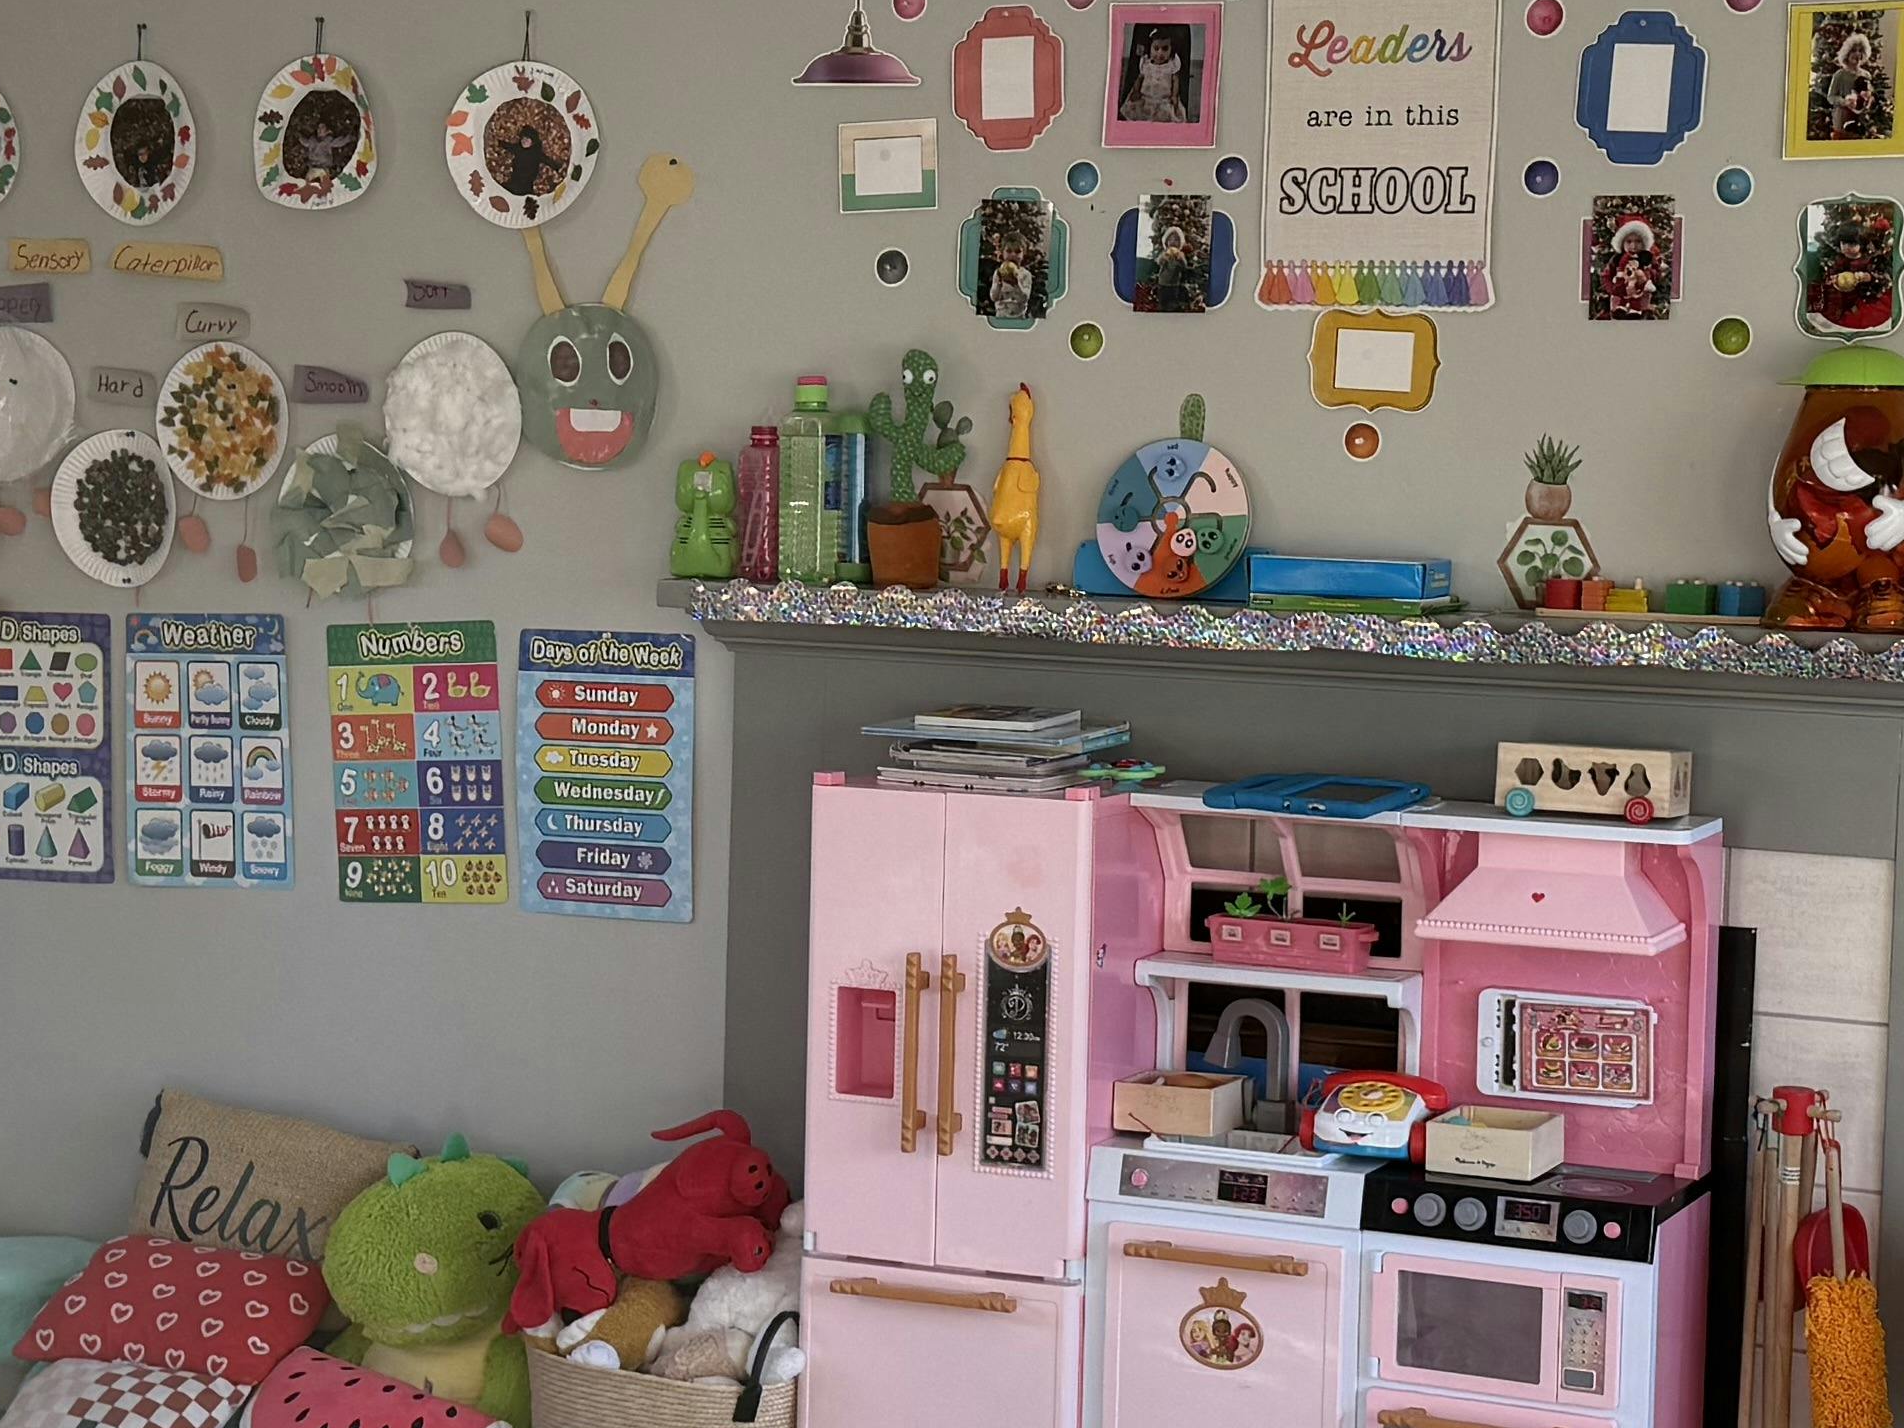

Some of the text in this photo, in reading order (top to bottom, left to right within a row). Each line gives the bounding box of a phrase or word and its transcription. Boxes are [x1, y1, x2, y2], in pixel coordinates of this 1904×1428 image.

[1288, 20, 1472, 78] Leaders
[1307, 104, 1459, 127] are in this
[1279, 166, 1476, 214] SCHOOL
[15, 243, 218, 273] Sensory Caterpillar
[184, 308, 238, 334] Curvy
[98, 373, 144, 399] Hard
[21, 623, 79, 644] Shapes
[162, 621, 254, 649] Weather
[359, 632, 463, 657] Numbers
[533, 638, 682, 668] Days of the Week
[336, 673, 348, 701] 1
[422, 672, 439, 701] 2
[574, 685, 638, 706] Sunday
[245, 714, 274, 727] Cloudy
[571, 717, 640, 740] Monday
[338, 722, 354, 749] 3
[423, 720, 440, 748] 4
[23, 757, 78, 777] Shapes
[568, 749, 640, 771] Tuesday
[142, 786, 176, 799] Stormy
[340, 768, 356, 795] 5
[426, 767, 443, 794] 6
[554, 781, 655, 805] Wednesday
[199, 788, 225, 800] Rainy
[344, 815, 358, 843] 7
[428, 812, 444, 839] 8
[564, 814, 643, 837] Thursday
[145, 861, 174, 874] Foggy
[577, 847, 631, 869] Friday
[346, 861, 362, 888] 9
[426, 858, 457, 888] 10
[565, 878, 642, 901] Saturday
[149, 1134, 332, 1264] Relax
